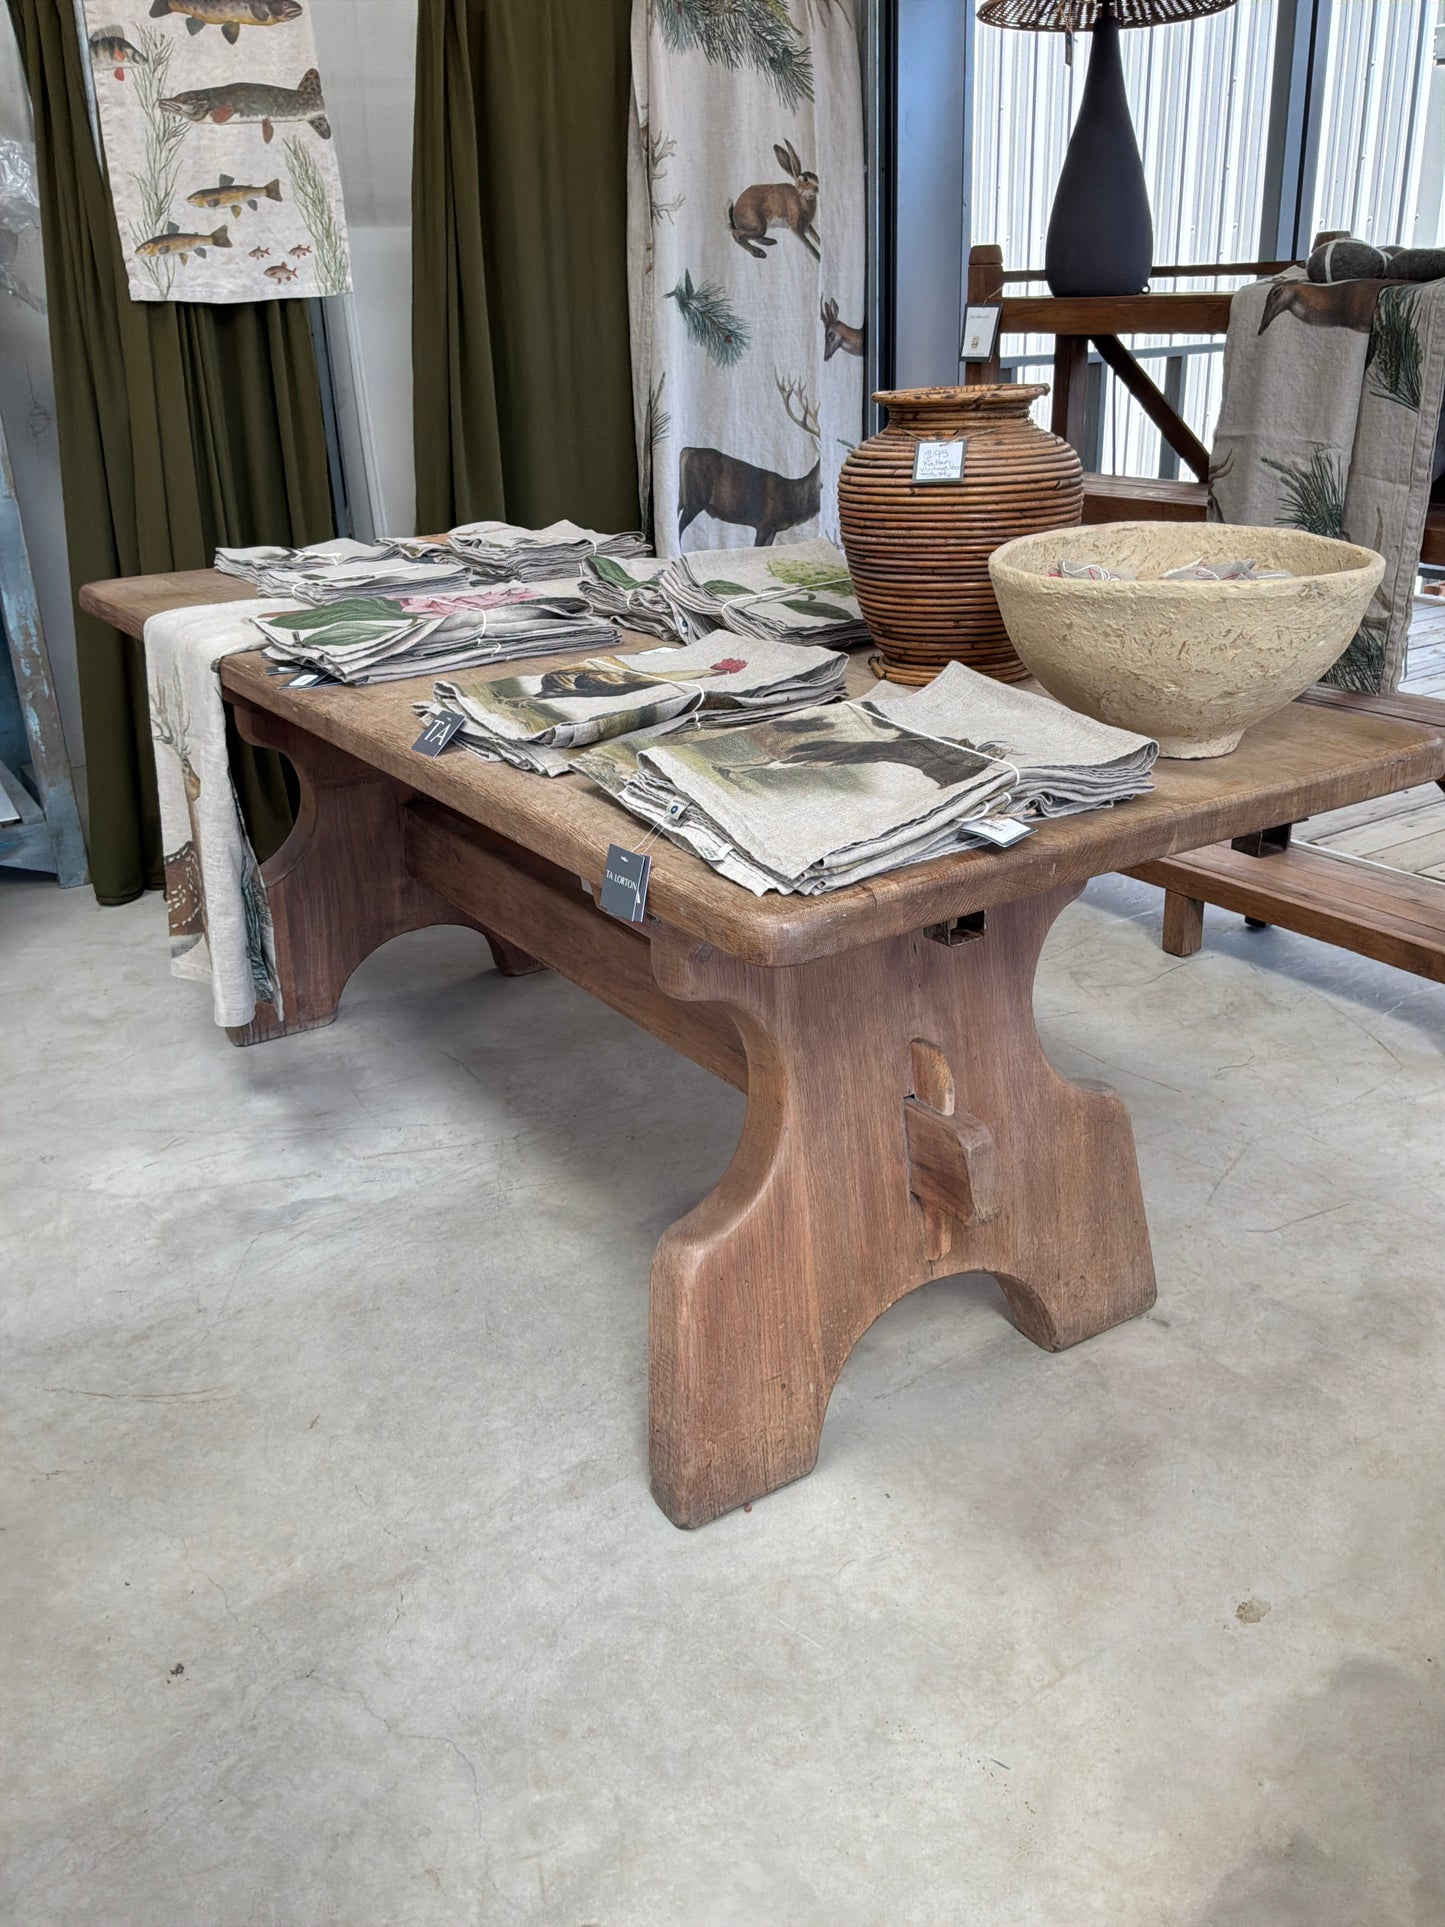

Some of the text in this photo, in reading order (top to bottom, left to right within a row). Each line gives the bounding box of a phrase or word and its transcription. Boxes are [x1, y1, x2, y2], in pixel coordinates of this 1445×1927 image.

[424, 719, 451, 746] TA
[606, 869, 637, 891] TA LORTON
